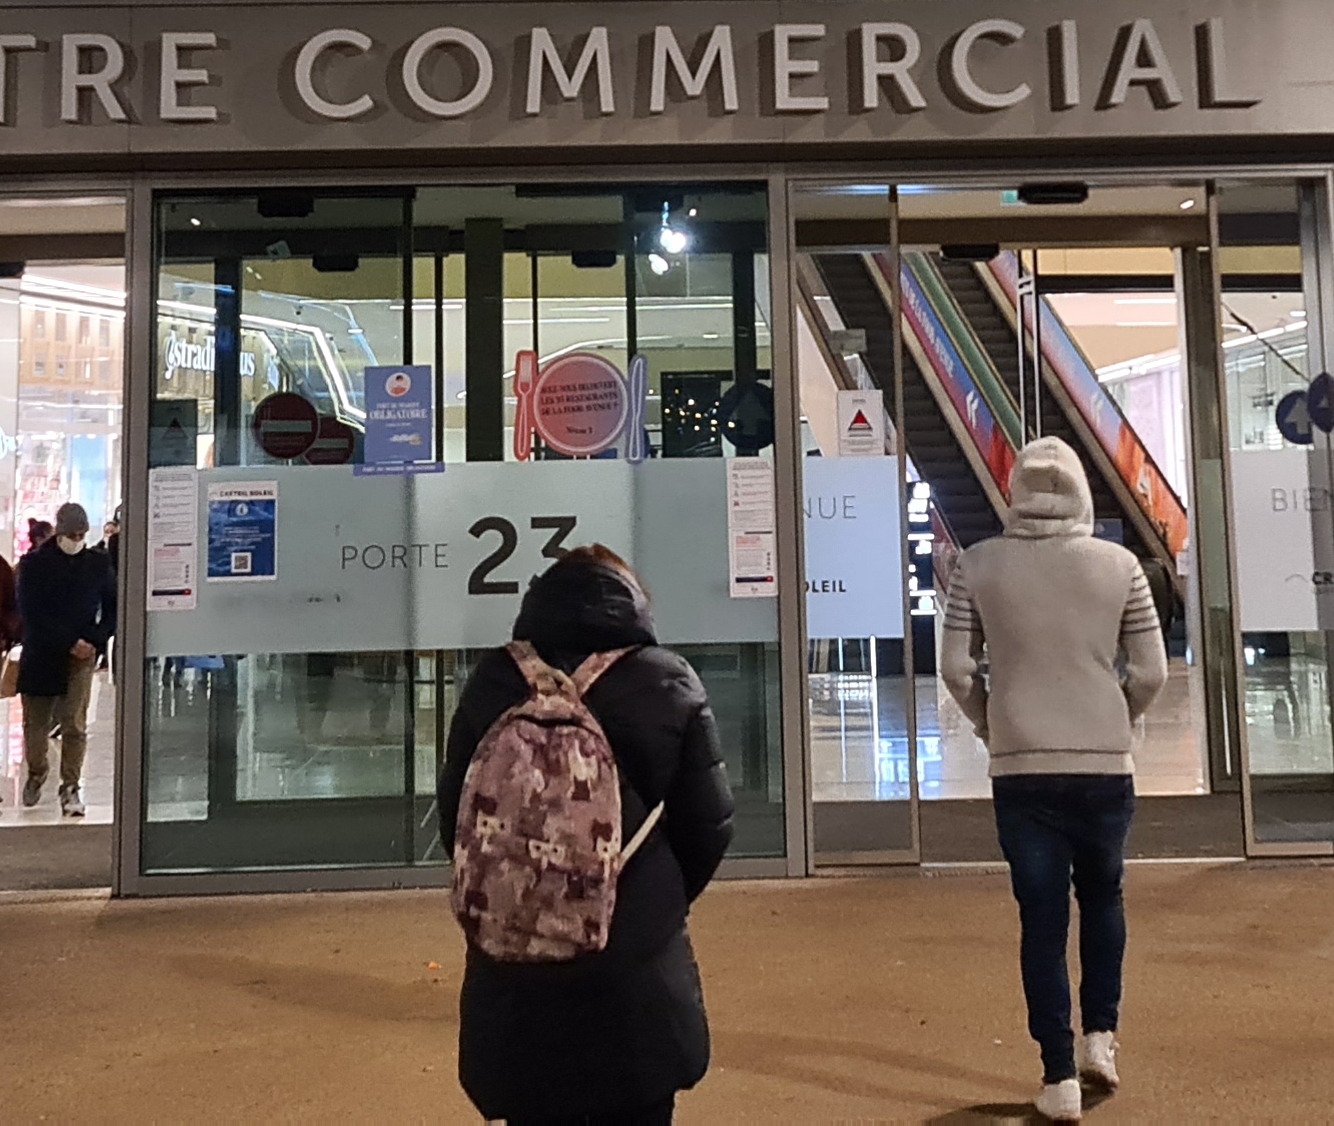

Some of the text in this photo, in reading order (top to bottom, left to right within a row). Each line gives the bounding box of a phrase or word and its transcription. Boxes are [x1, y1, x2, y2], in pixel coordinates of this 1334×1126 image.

[293, 17, 1263, 120] COMMERCIAL
[340, 515, 578, 596] PORTE 23
[804, 579, 848, 594] OLEIL
